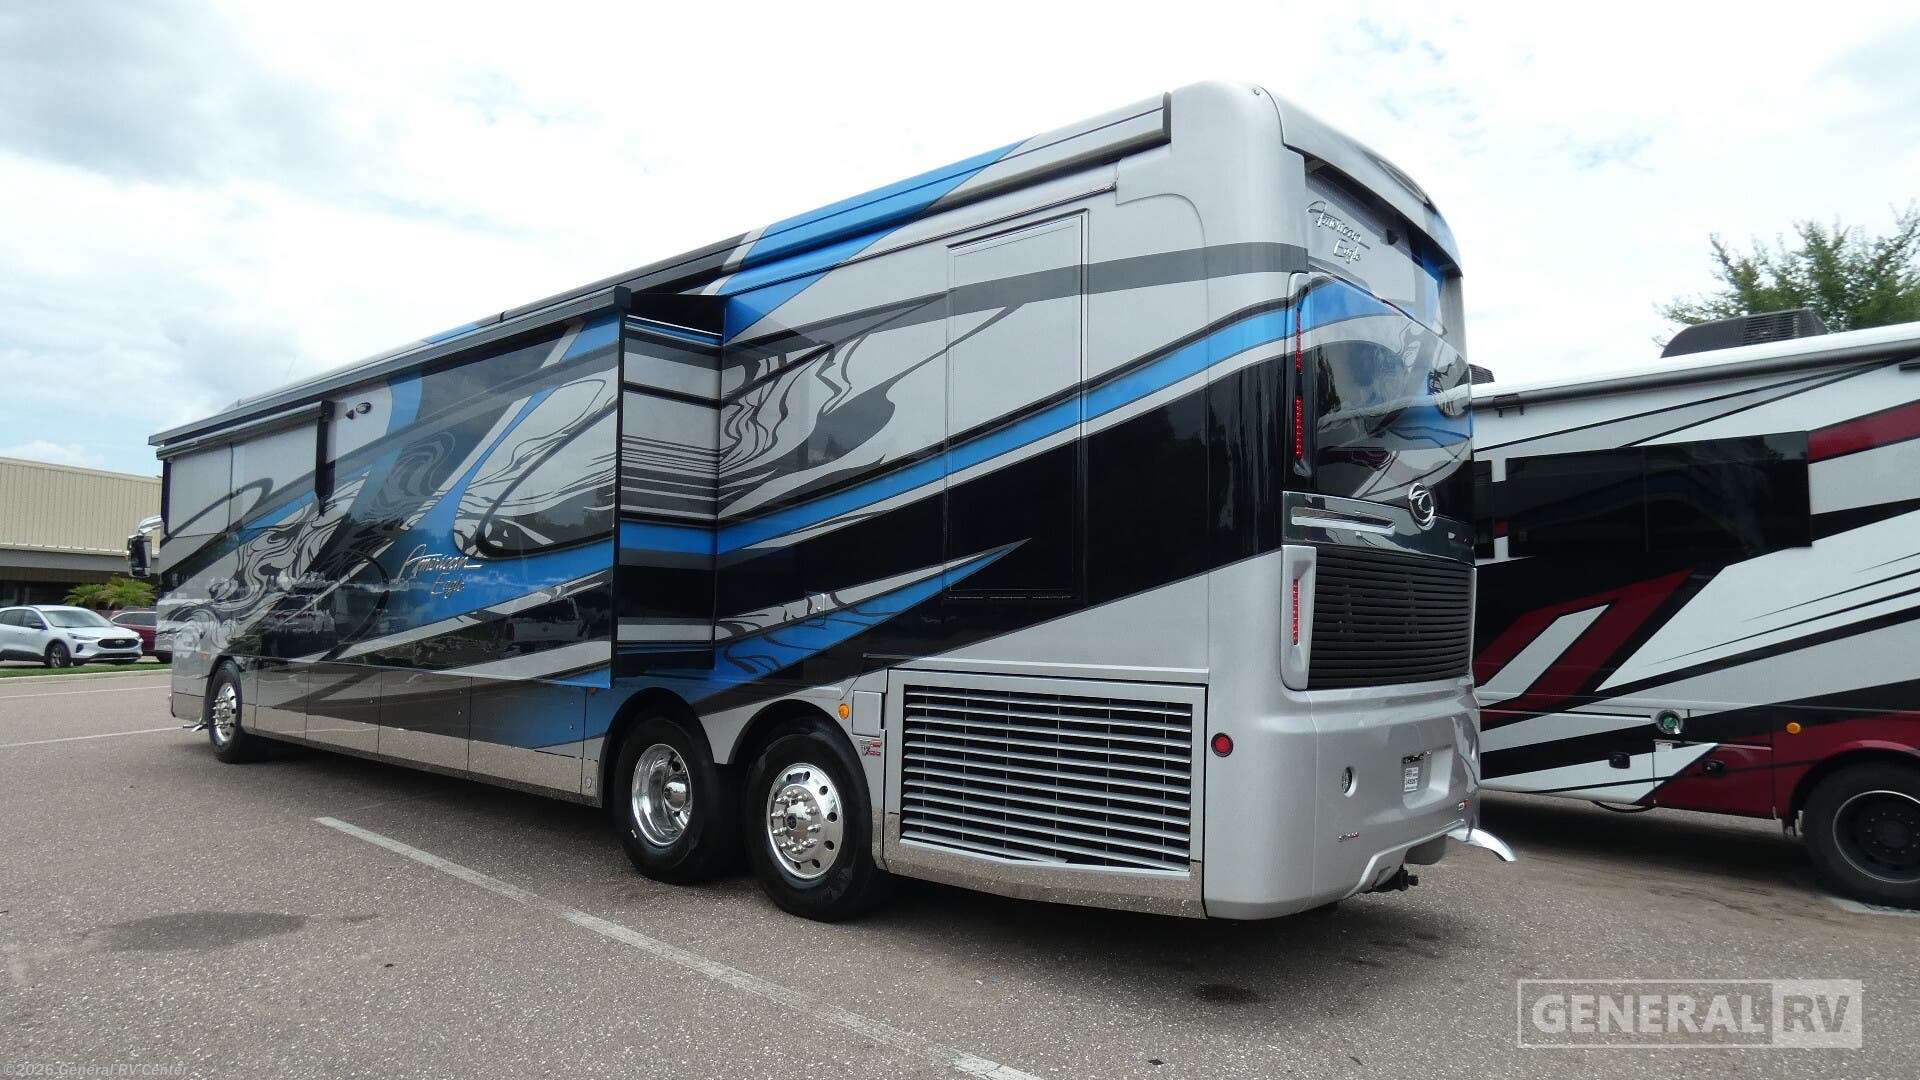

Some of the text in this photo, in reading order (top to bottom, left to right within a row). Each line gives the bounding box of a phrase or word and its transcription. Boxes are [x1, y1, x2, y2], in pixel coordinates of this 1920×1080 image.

[1306, 200, 1370, 249] American
[1332, 239, 1361, 264] Eagle
[394, 543, 483, 584] American
[430, 572, 465, 599] Eagle
